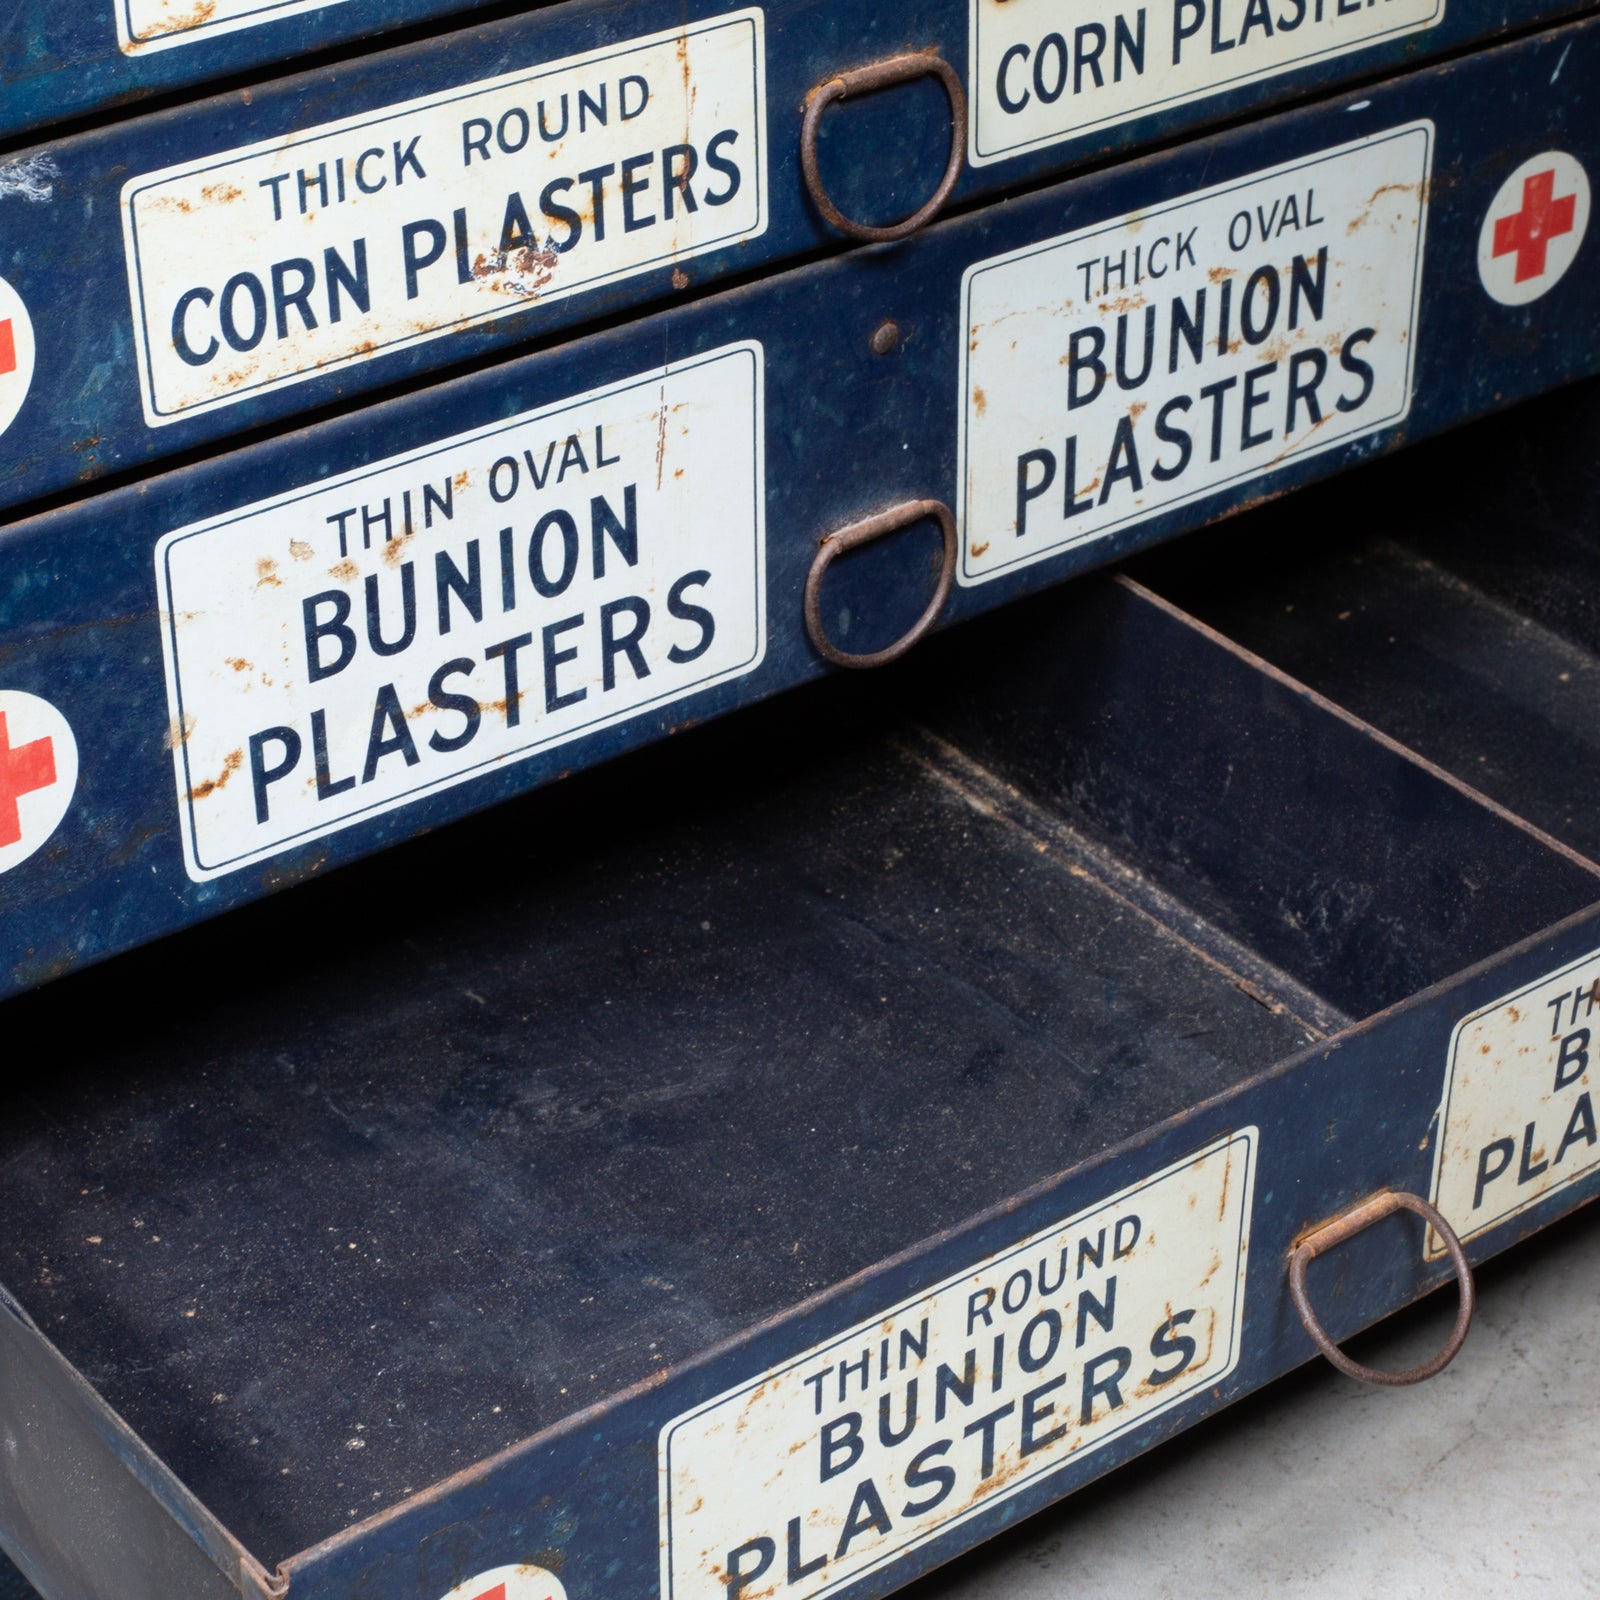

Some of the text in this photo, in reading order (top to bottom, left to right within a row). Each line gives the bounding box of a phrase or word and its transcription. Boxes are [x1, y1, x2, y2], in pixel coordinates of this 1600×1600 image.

[258, 74, 650, 222] THICK ROUND
[996, 7, 1146, 114] CORN
[171, 128, 742, 367] CORN PLASTERS
[1066, 246, 1328, 411] BUNION
[1077, 188, 1325, 302] THICK OVAL
[326, 424, 621, 558] THIN OVAL
[1014, 327, 1376, 538] PLASTERS
[301, 483, 640, 684] BUNION
[248, 570, 716, 825] PLASTERS
[1553, 1027, 1591, 1093] B
[803, 1214, 1142, 1415] THIN ROUND
[818, 1276, 1117, 1483] BUNION
[726, 1308, 1197, 1600] PLASTERS
